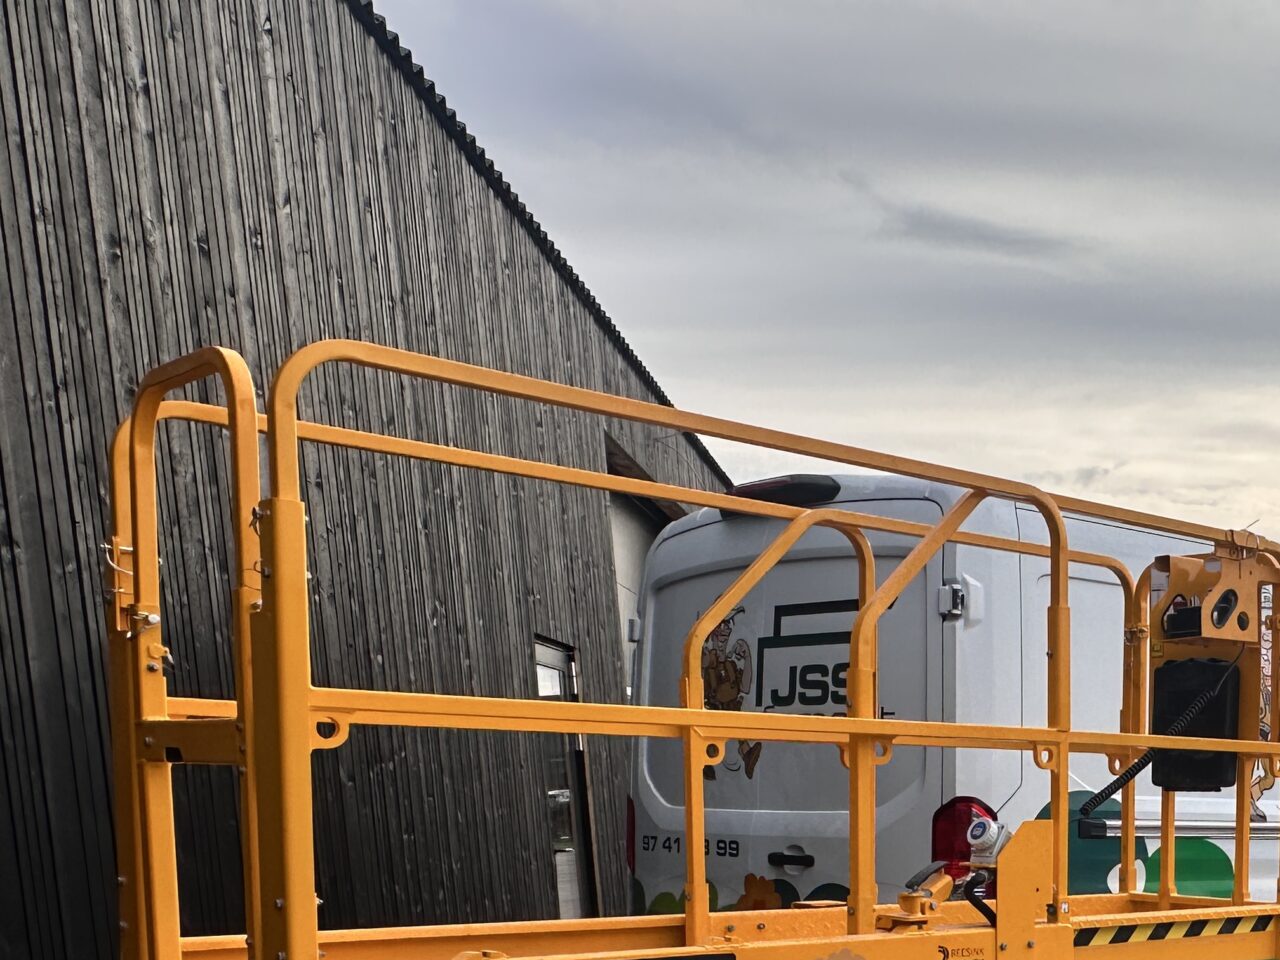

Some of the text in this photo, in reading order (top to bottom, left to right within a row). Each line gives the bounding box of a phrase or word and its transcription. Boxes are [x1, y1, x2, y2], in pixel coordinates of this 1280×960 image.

[642, 835, 658, 852] 97
[662, 836, 681, 854] 41
[716, 839, 740, 857] 99
